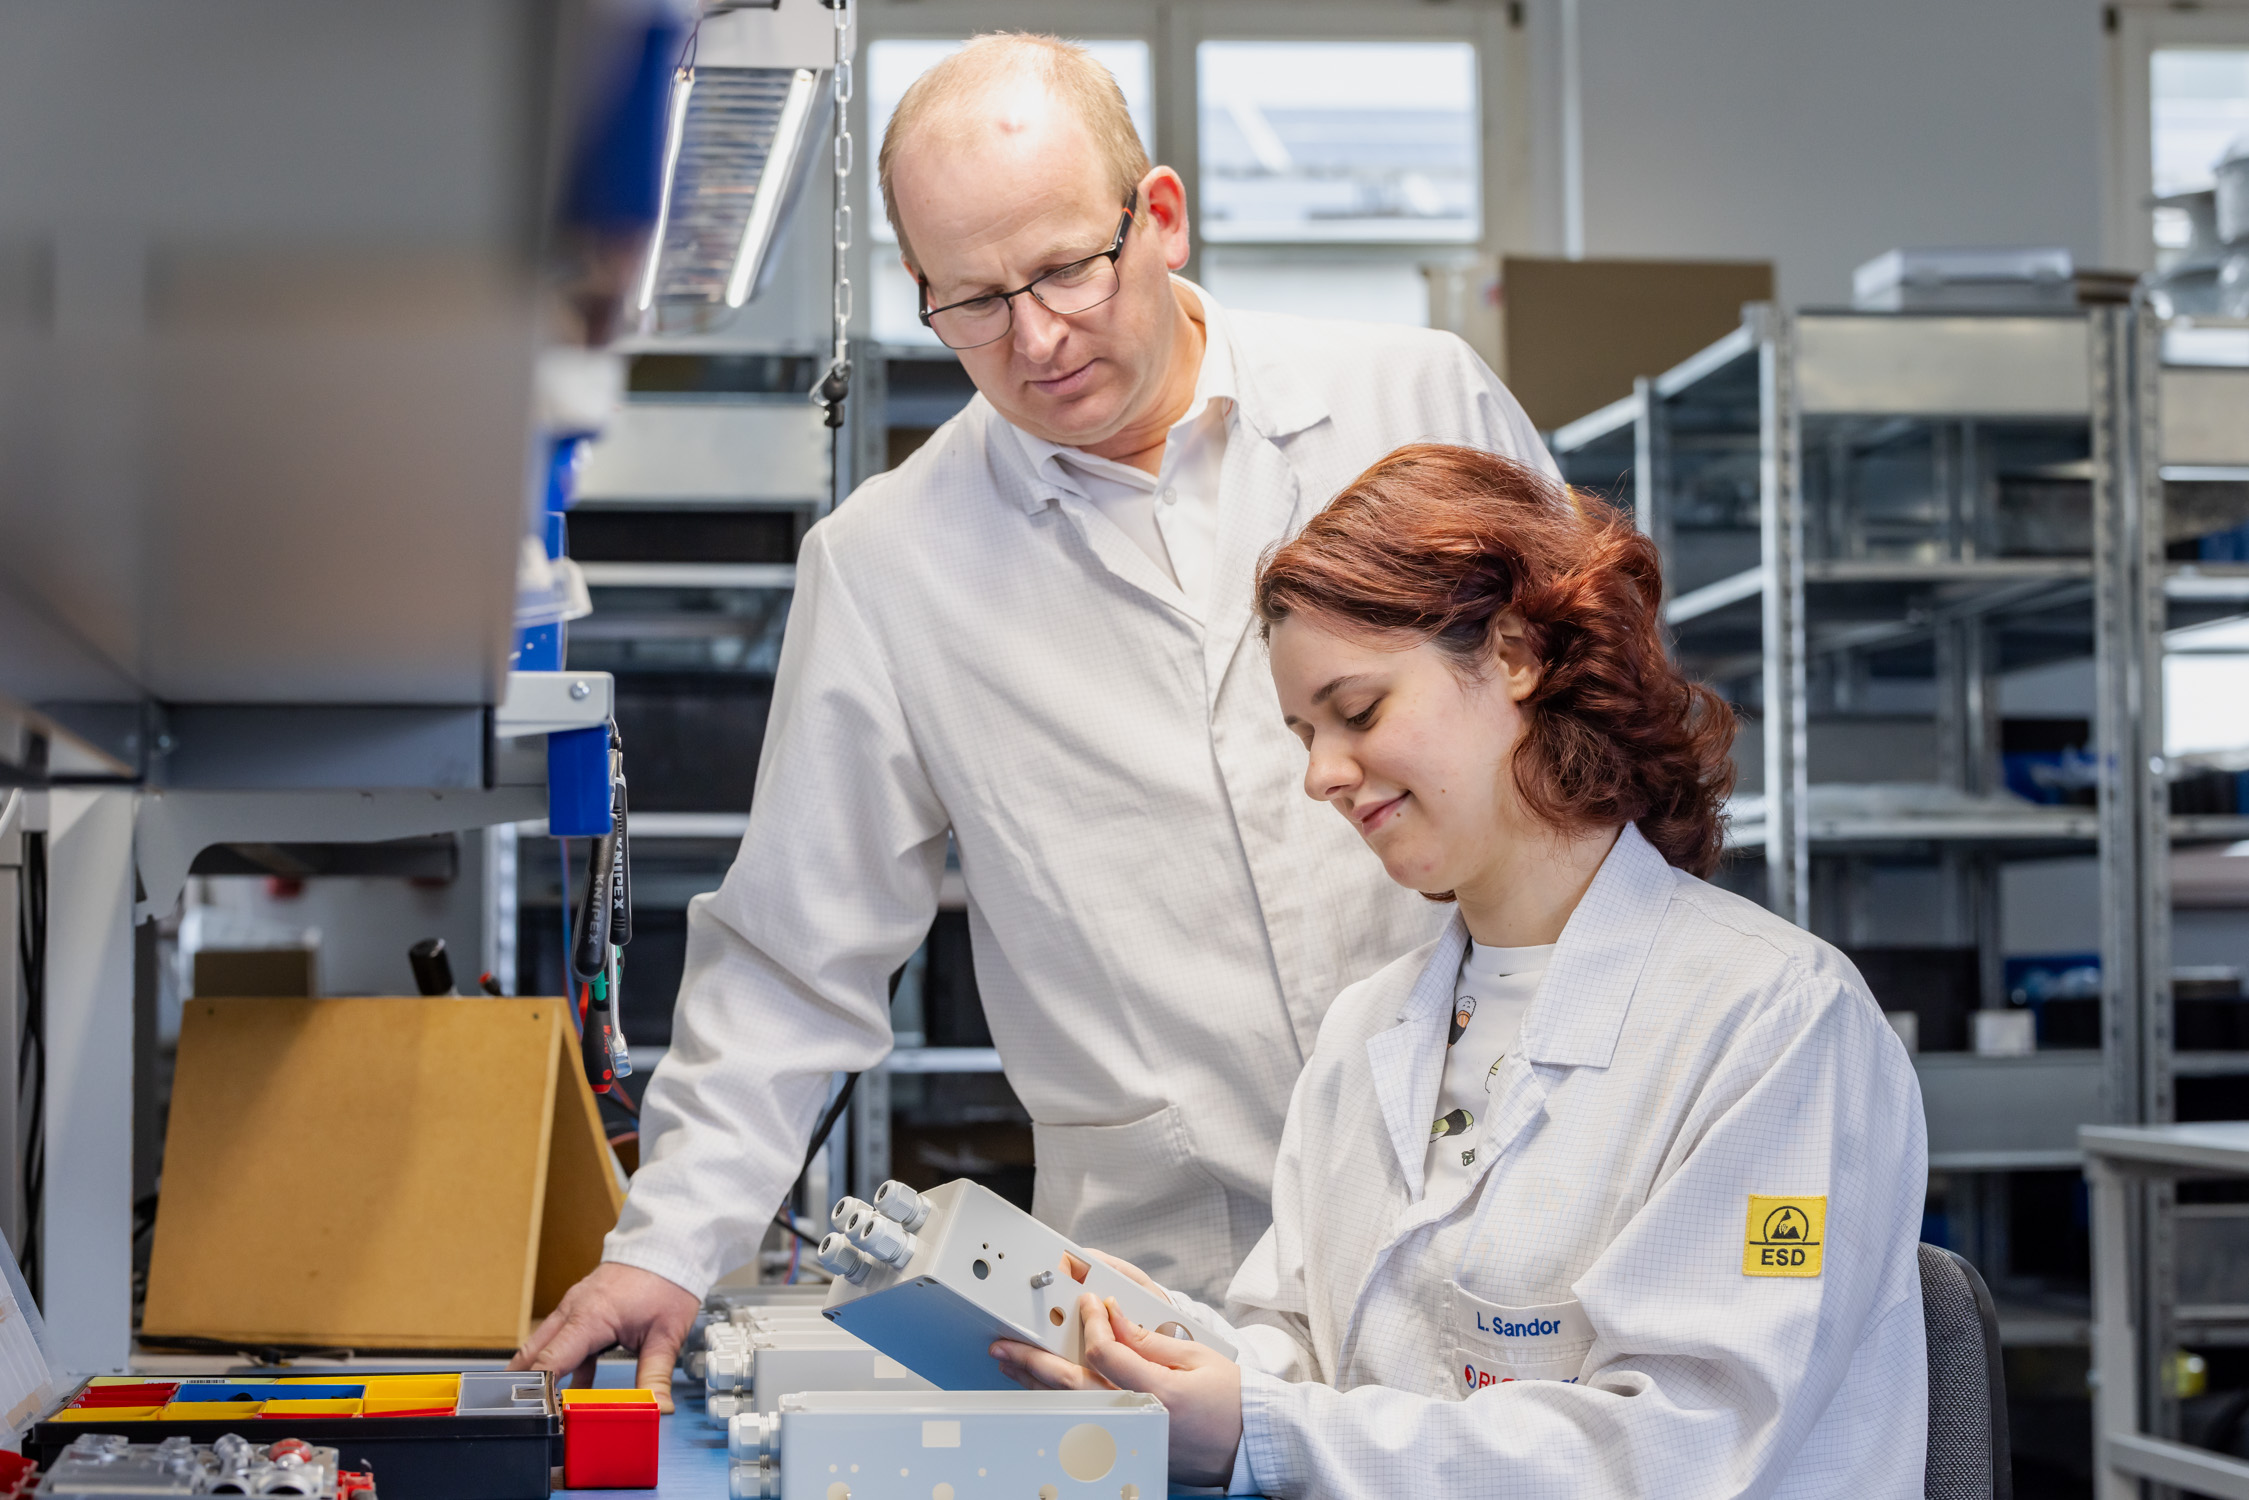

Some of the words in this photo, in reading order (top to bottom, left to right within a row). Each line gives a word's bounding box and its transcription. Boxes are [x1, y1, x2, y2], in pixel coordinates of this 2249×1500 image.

[614, 837, 624, 910] KNIPEX
[588, 874, 605, 945] KNIPEX
[1760, 1248, 1806, 1267] ESD
[1477, 1311, 1490, 1332] L.
[1492, 1317, 1561, 1338] Sandor
